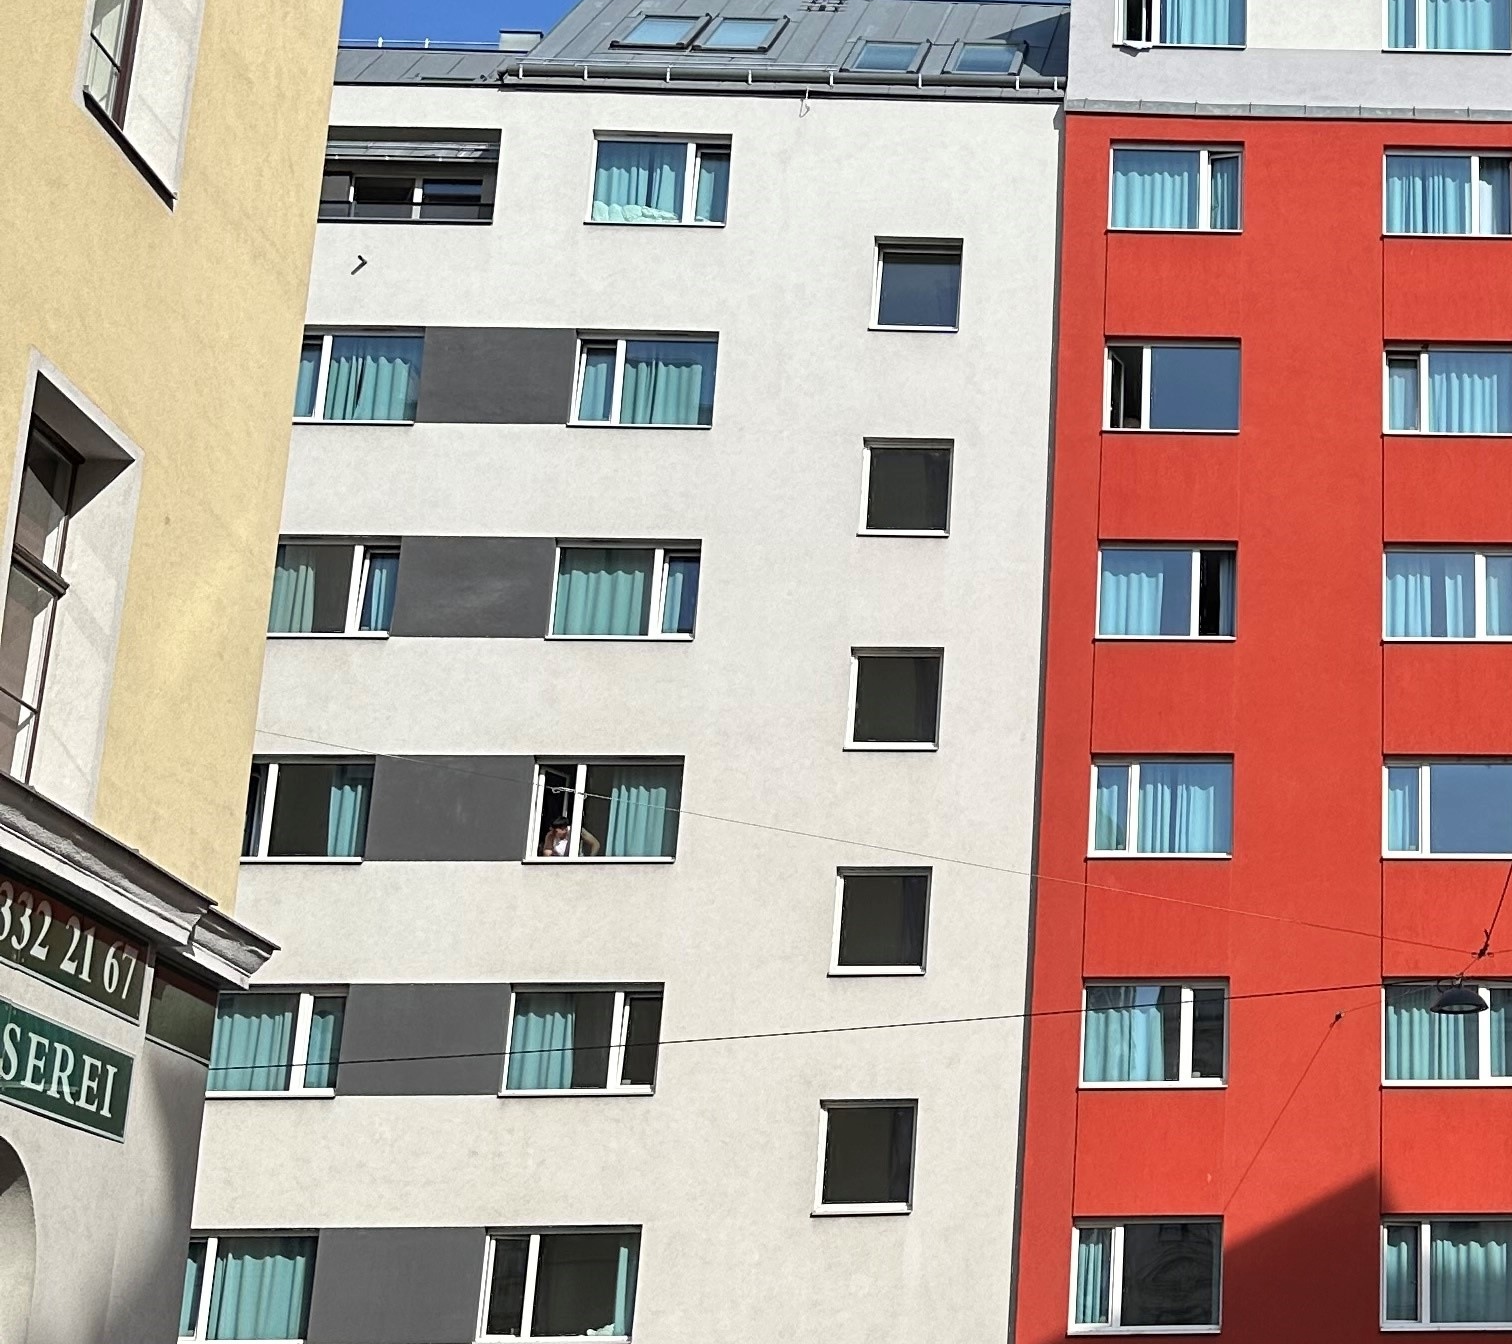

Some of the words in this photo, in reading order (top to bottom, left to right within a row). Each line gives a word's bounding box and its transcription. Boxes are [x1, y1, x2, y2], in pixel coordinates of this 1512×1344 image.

[0, 881, 52, 960] 332
[60, 916, 96, 982] 21
[103, 941, 139, 999] 67
[0, 1022, 118, 1117] SEREI
